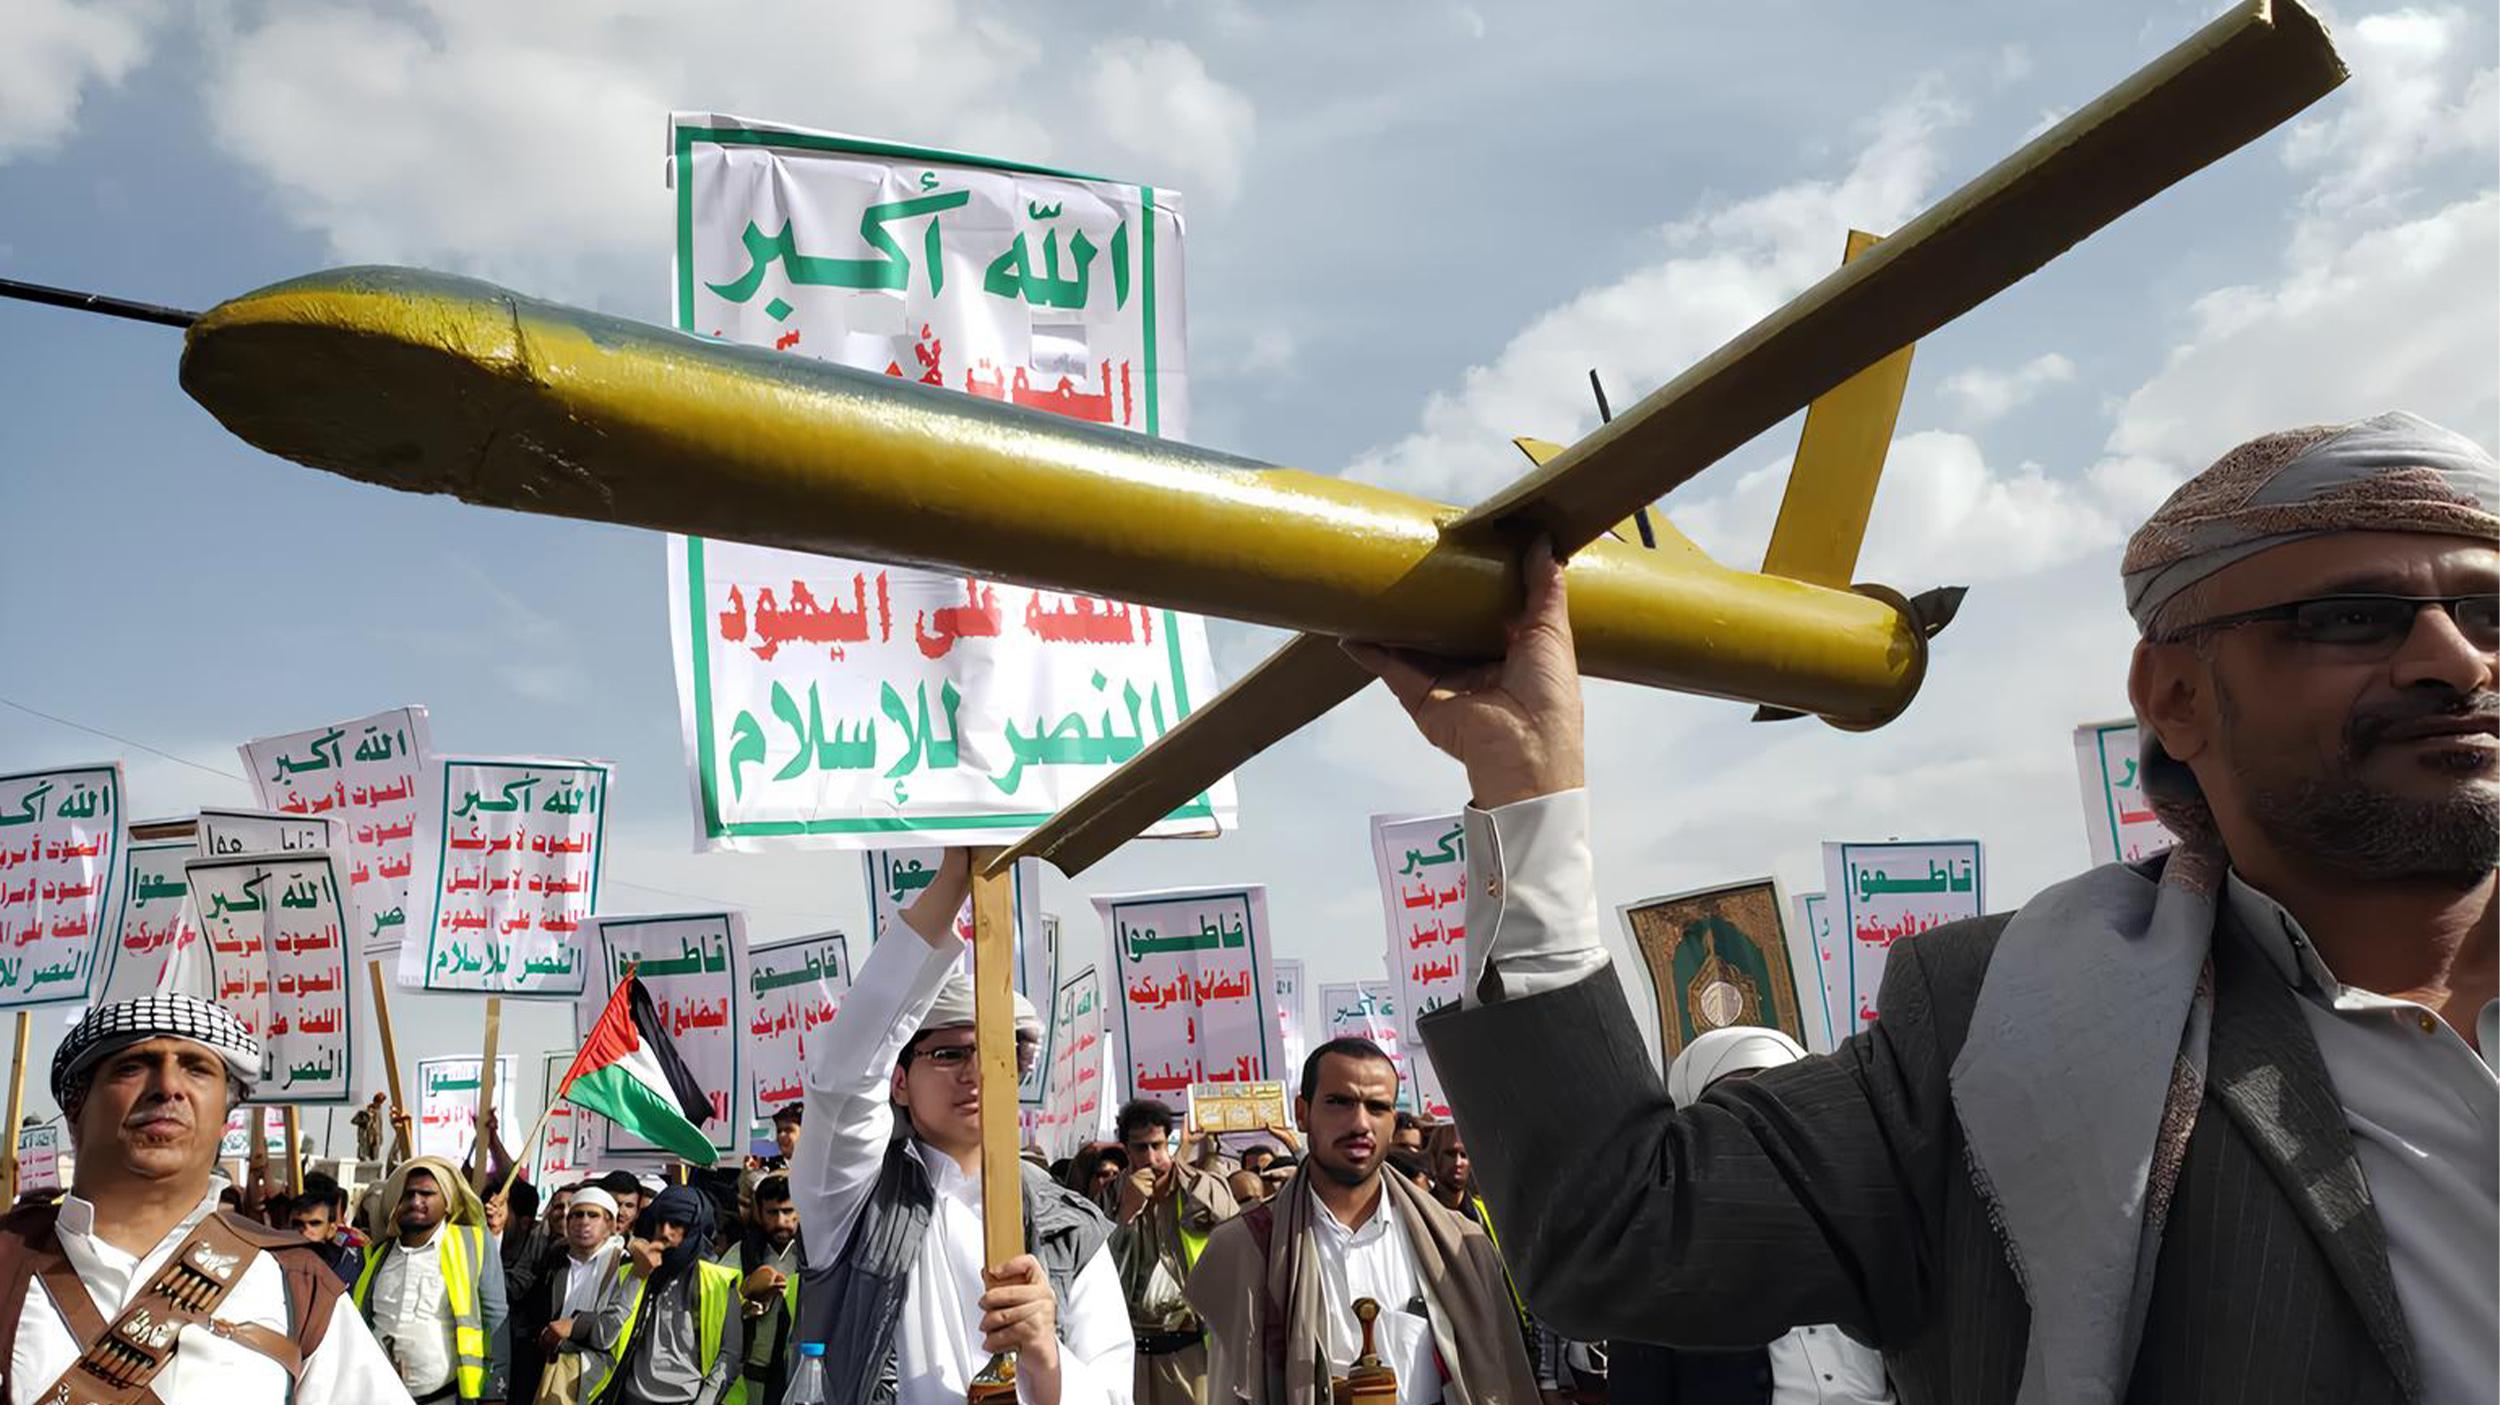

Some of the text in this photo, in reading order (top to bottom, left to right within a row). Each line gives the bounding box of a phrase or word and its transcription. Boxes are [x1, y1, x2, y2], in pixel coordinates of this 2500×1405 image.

[704, 171, 1130, 321] الله أكبر
[720, 570, 890, 661] اليهود
[272, 726, 406, 785] الله أكبر
[731, 668, 1167, 804] النصر للإسلام
[57, 783, 110, 818] الله
[352, 775, 415, 807] الموت
[452, 772, 596, 821] الله أكبر
[46, 831, 108, 863] الموت
[532, 832, 592, 858] الموت
[1399, 823, 1465, 879] أكبر
[42, 873, 103, 904] الموت
[132, 867, 188, 908] عوا
[207, 867, 332, 924] الله أكبر
[528, 869, 588, 898] الموت
[1851, 860, 1972, 902] قاطعوا
[15, 918, 43, 947] على
[275, 923, 339, 956] الموت
[441, 906, 494, 935] اليهود
[500, 908, 530, 935] على
[1121, 912, 1245, 963] قاطعوا
[24, 947, 90, 994] النصر
[278, 966, 342, 998] الموت
[516, 942, 582, 983] النصر
[1129, 964, 1251, 1010] البضائع الأمريكية
[299, 1007, 342, 1034] اللعنة
[282, 1045, 342, 1090] النصر
